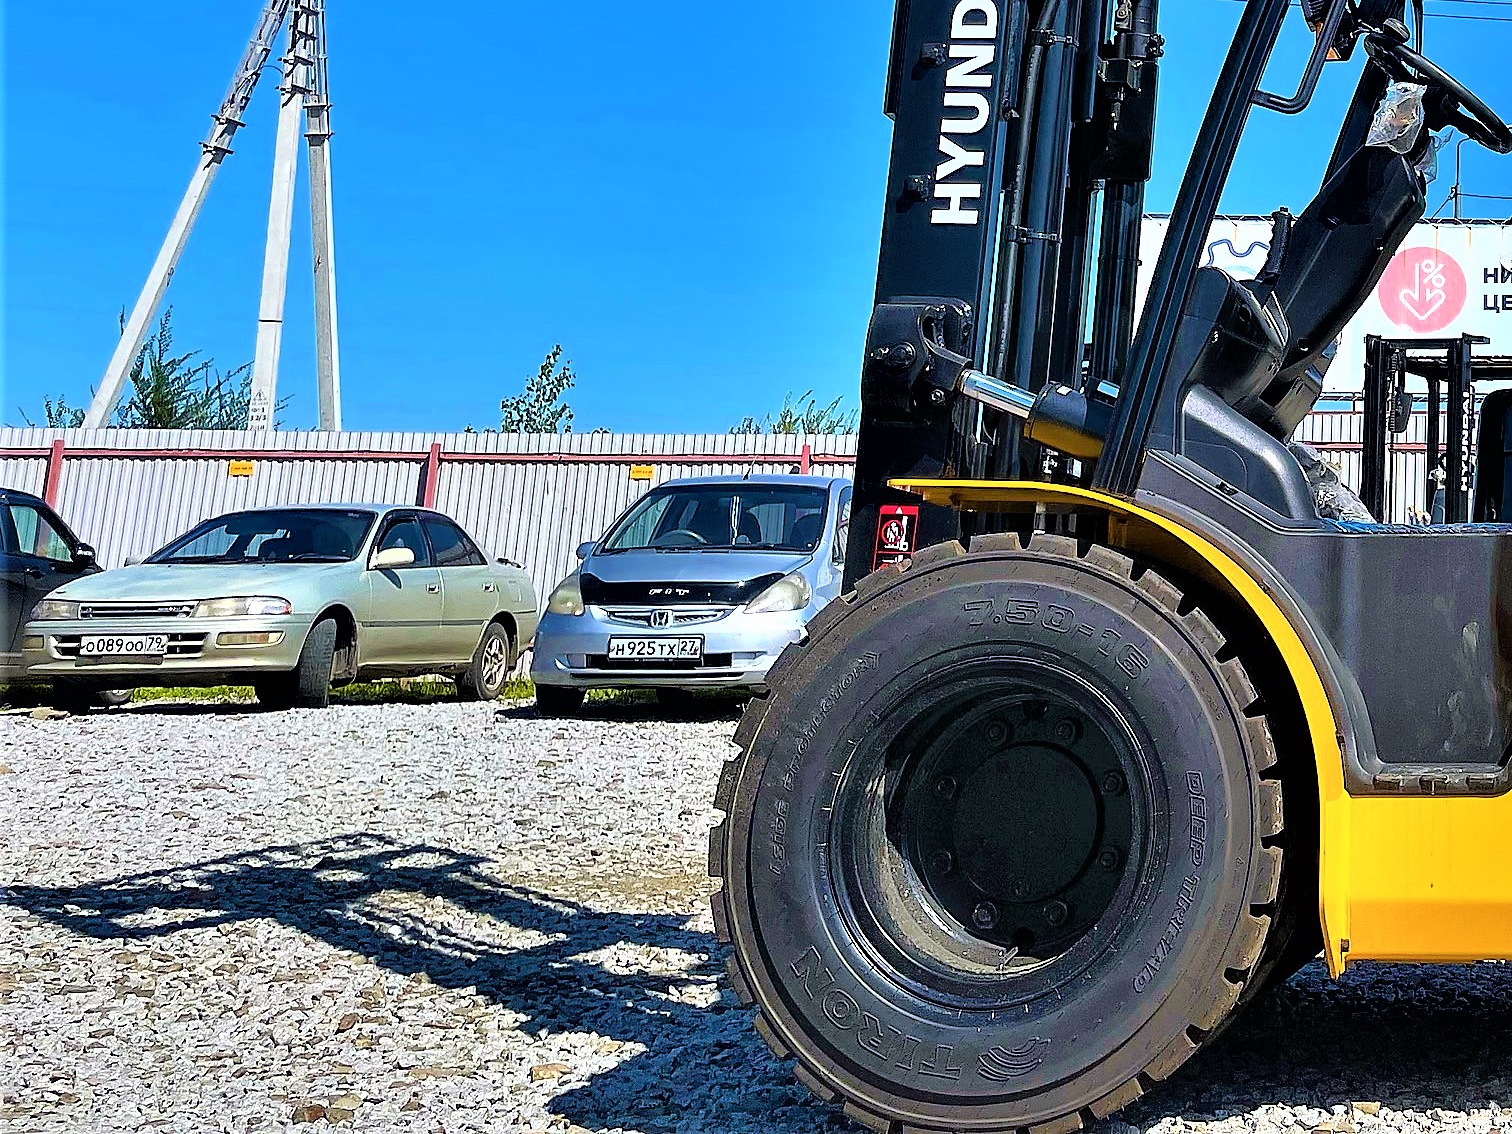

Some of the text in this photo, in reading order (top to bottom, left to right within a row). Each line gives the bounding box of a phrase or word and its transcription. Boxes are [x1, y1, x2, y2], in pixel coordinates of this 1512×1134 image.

[1461, 391, 1470, 492] HYUNDAI
[963, 597, 1150, 680] 7.50-16
[1185, 770, 1207, 867] DEEP
[789, 945, 962, 1081] TIRON
